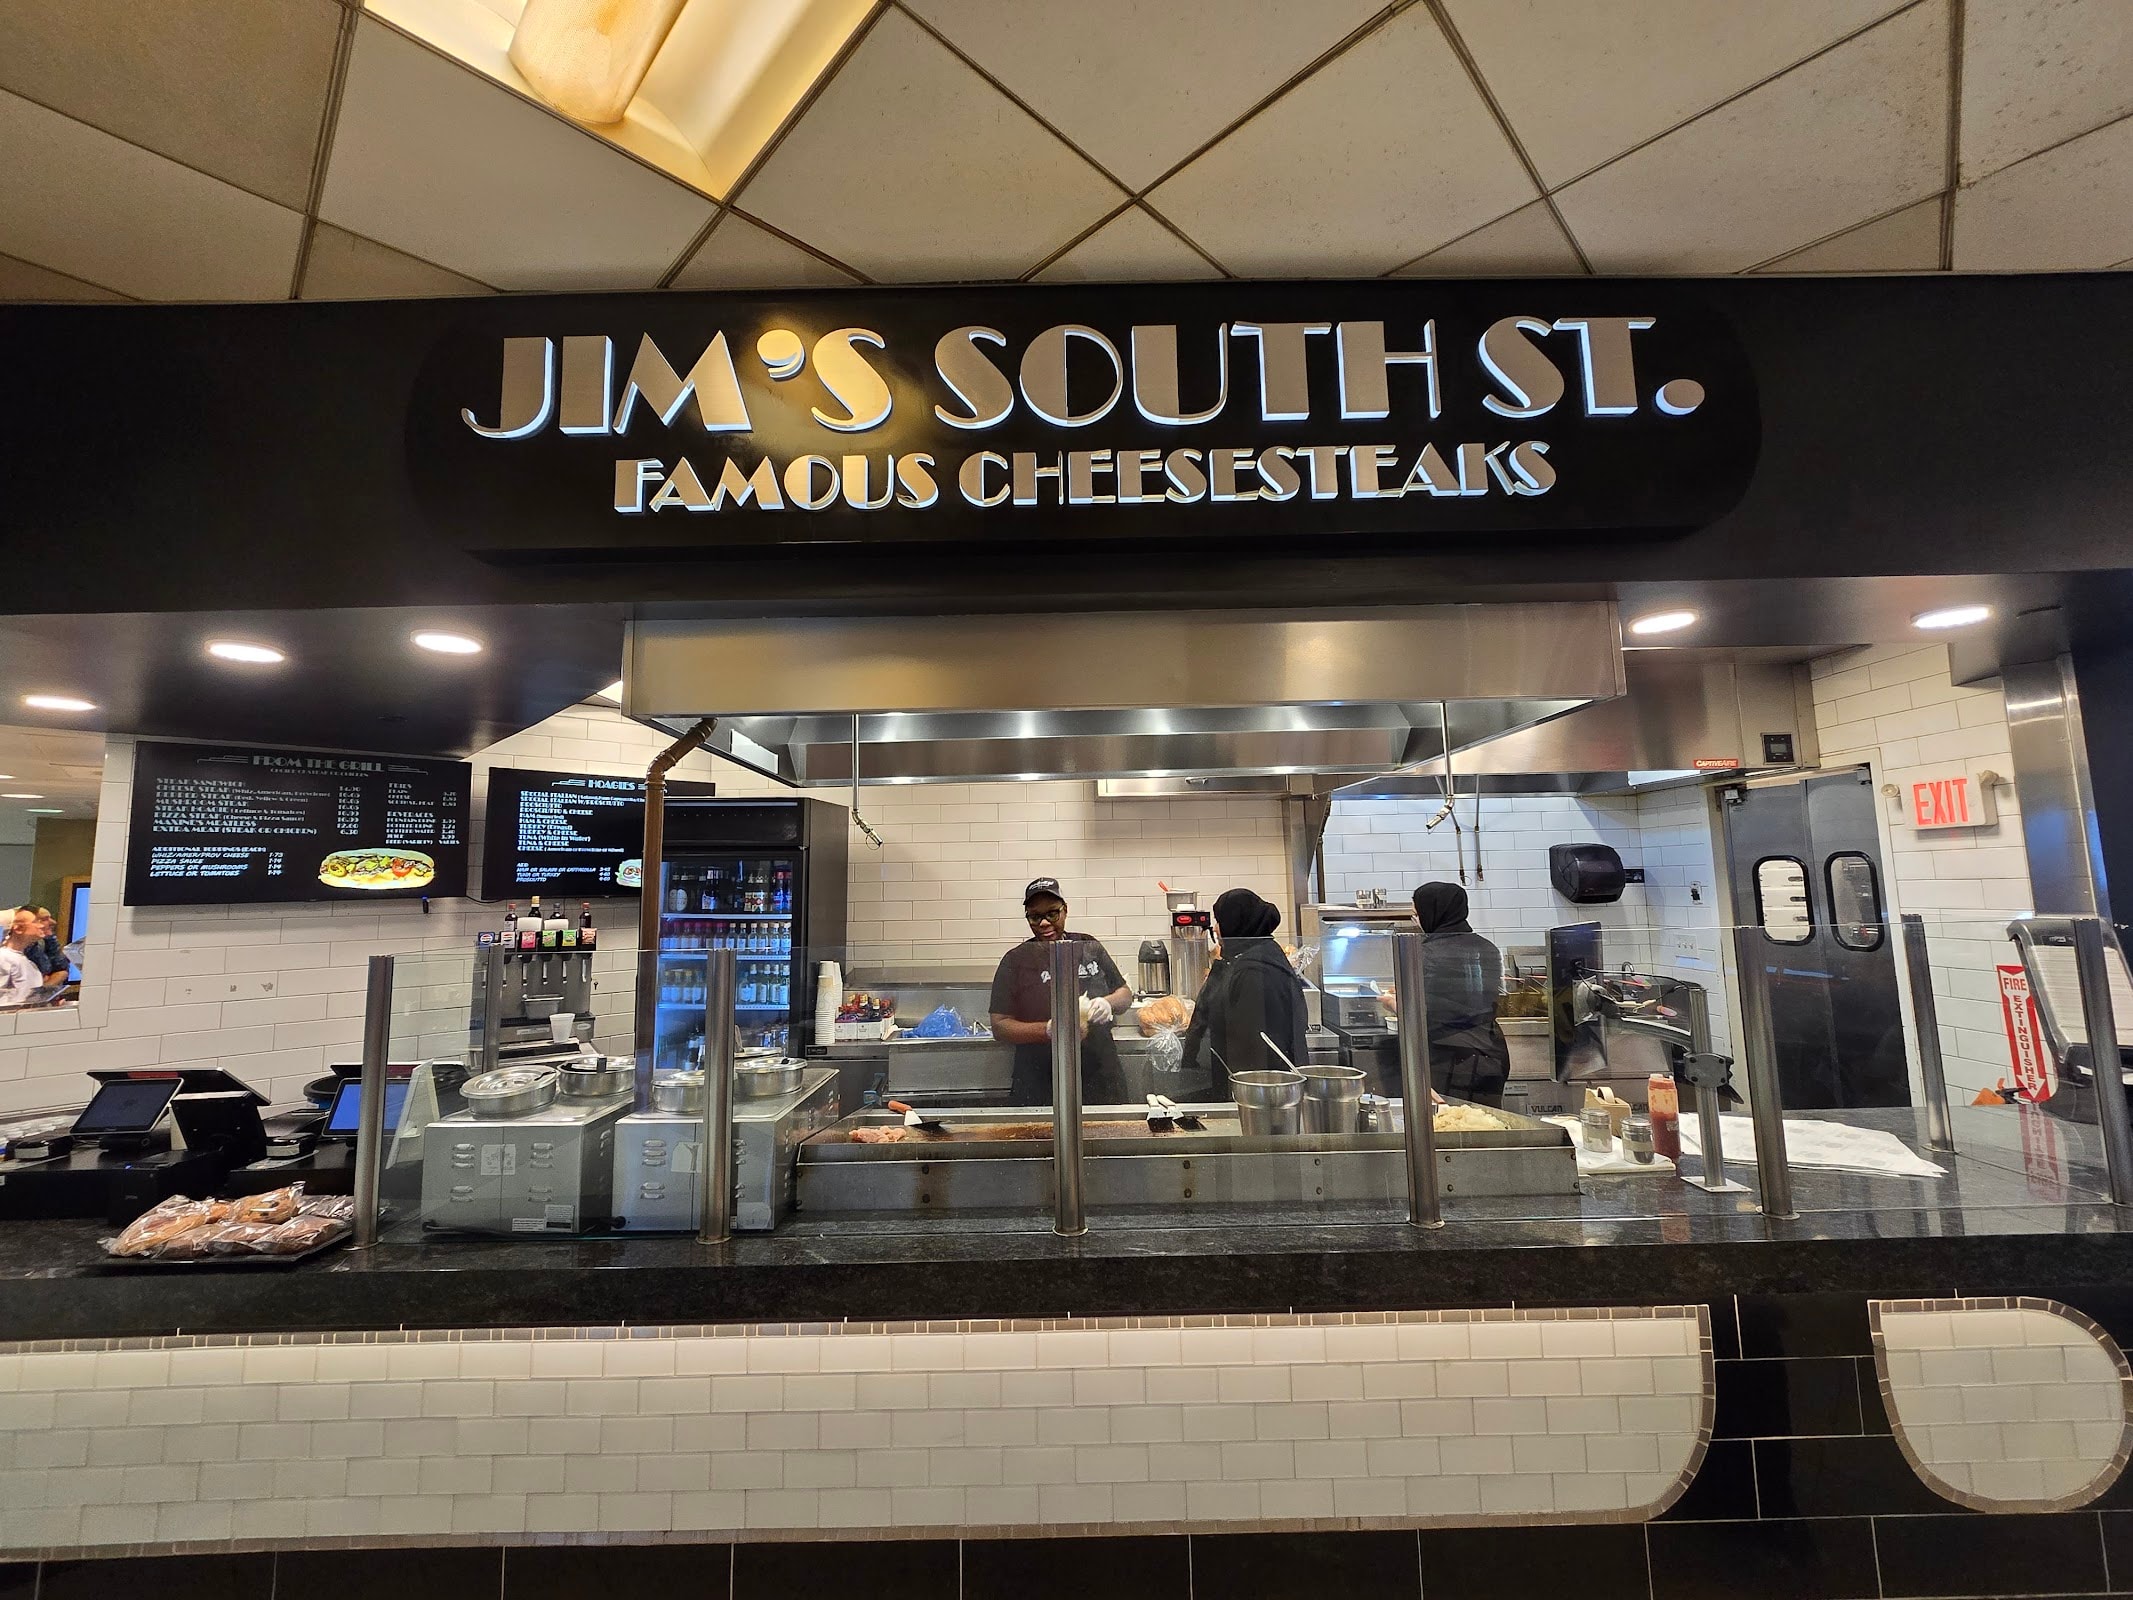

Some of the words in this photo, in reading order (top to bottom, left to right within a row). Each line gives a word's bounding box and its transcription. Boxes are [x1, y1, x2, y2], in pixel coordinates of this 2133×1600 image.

[461, 327, 892, 439] JIM'S
[935, 319, 1441, 428] SOUTH
[1478, 315, 1705, 418] ST.
[614, 453, 938, 512] FAMOUS
[959, 441, 1557, 507] CHEESESTEAKS
[253, 756, 302, 766] FROM
[305, 759, 336, 769] THE
[339, 760, 385, 772] GRILL
[588, 780, 636, 790] HOAGIES
[1912, 778, 1969, 826] EXIT
[2003, 977, 2028, 991] FIRE
[2013, 994, 2038, 1091] EXTINGUISHER
